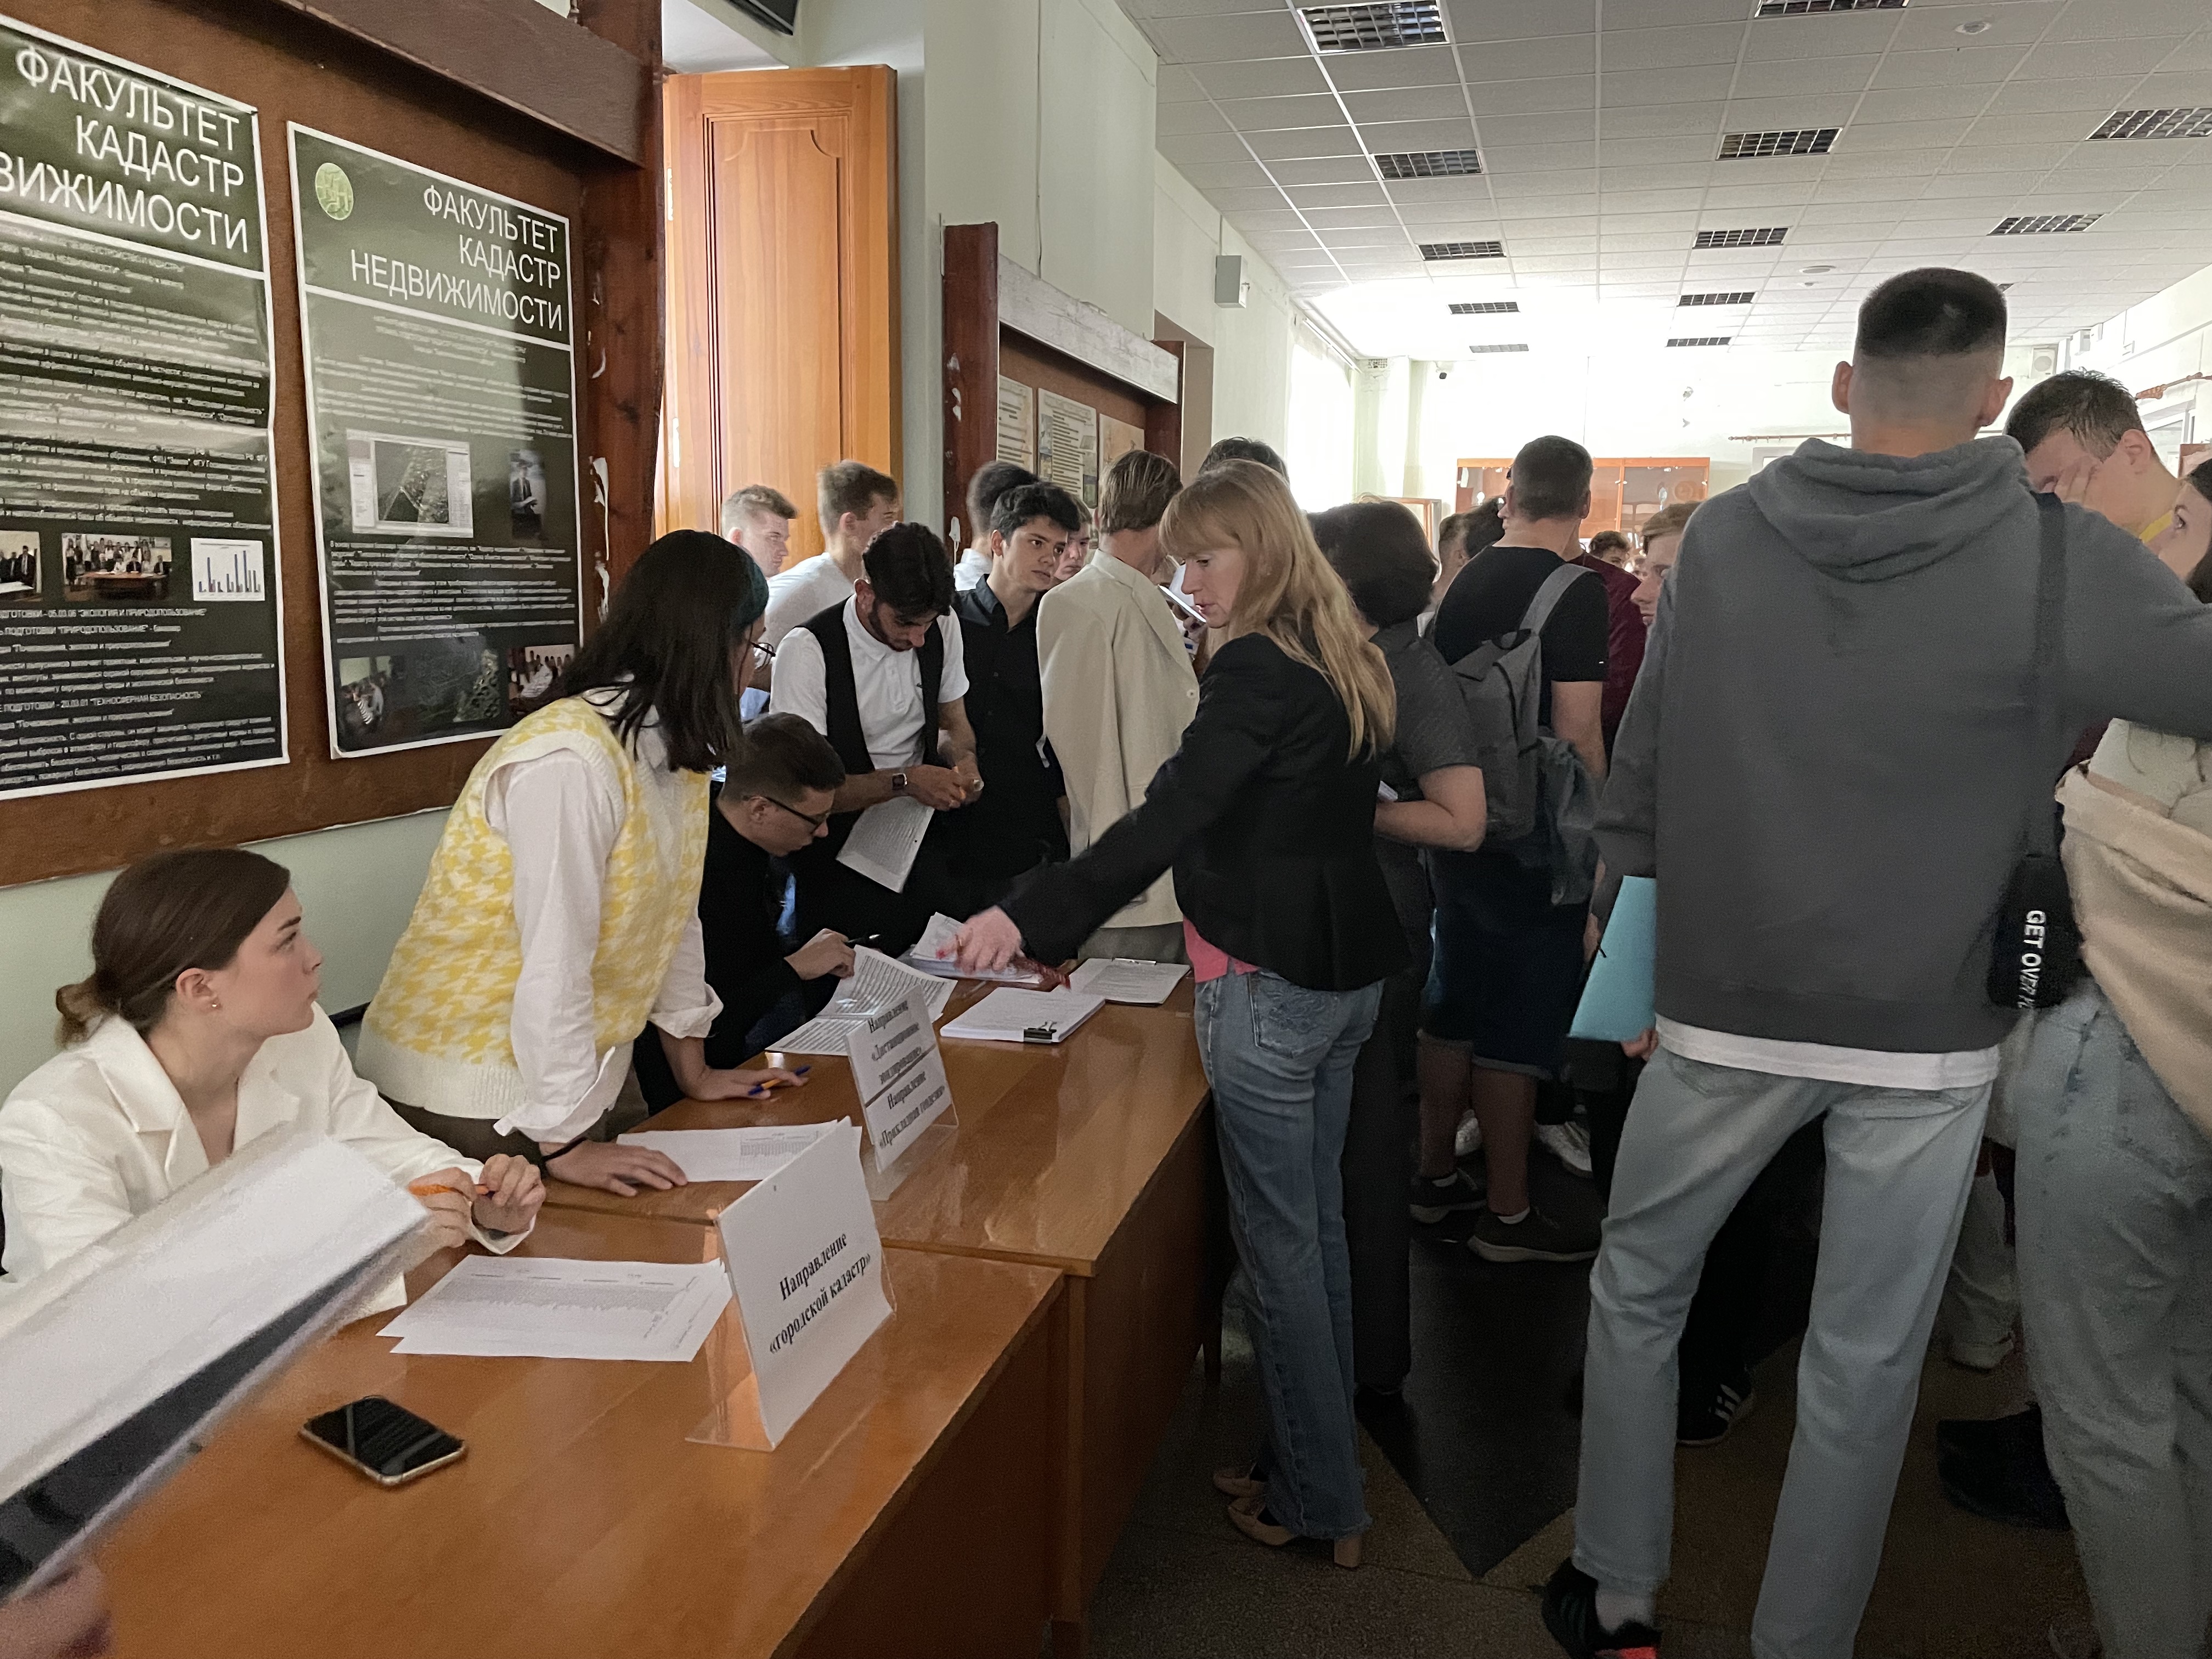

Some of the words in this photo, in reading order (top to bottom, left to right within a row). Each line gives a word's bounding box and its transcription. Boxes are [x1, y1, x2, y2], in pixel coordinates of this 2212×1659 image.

[16, 45, 239, 151] ФАКУЛЬТЕТ
[76, 115, 244, 197] КАДАСТР
[424, 185, 557, 253] ФАКУЛЬТЕТ
[351, 249, 562, 331] НЕДВИЖИМОСТИ
[460, 234, 560, 289] КАДАСТР
[2023, 910, 2046, 949] GET
[770, 1287, 829, 1355] «городской
[830, 1253, 871, 1299] кадастр»
[780, 1233, 847, 1301] Направление
